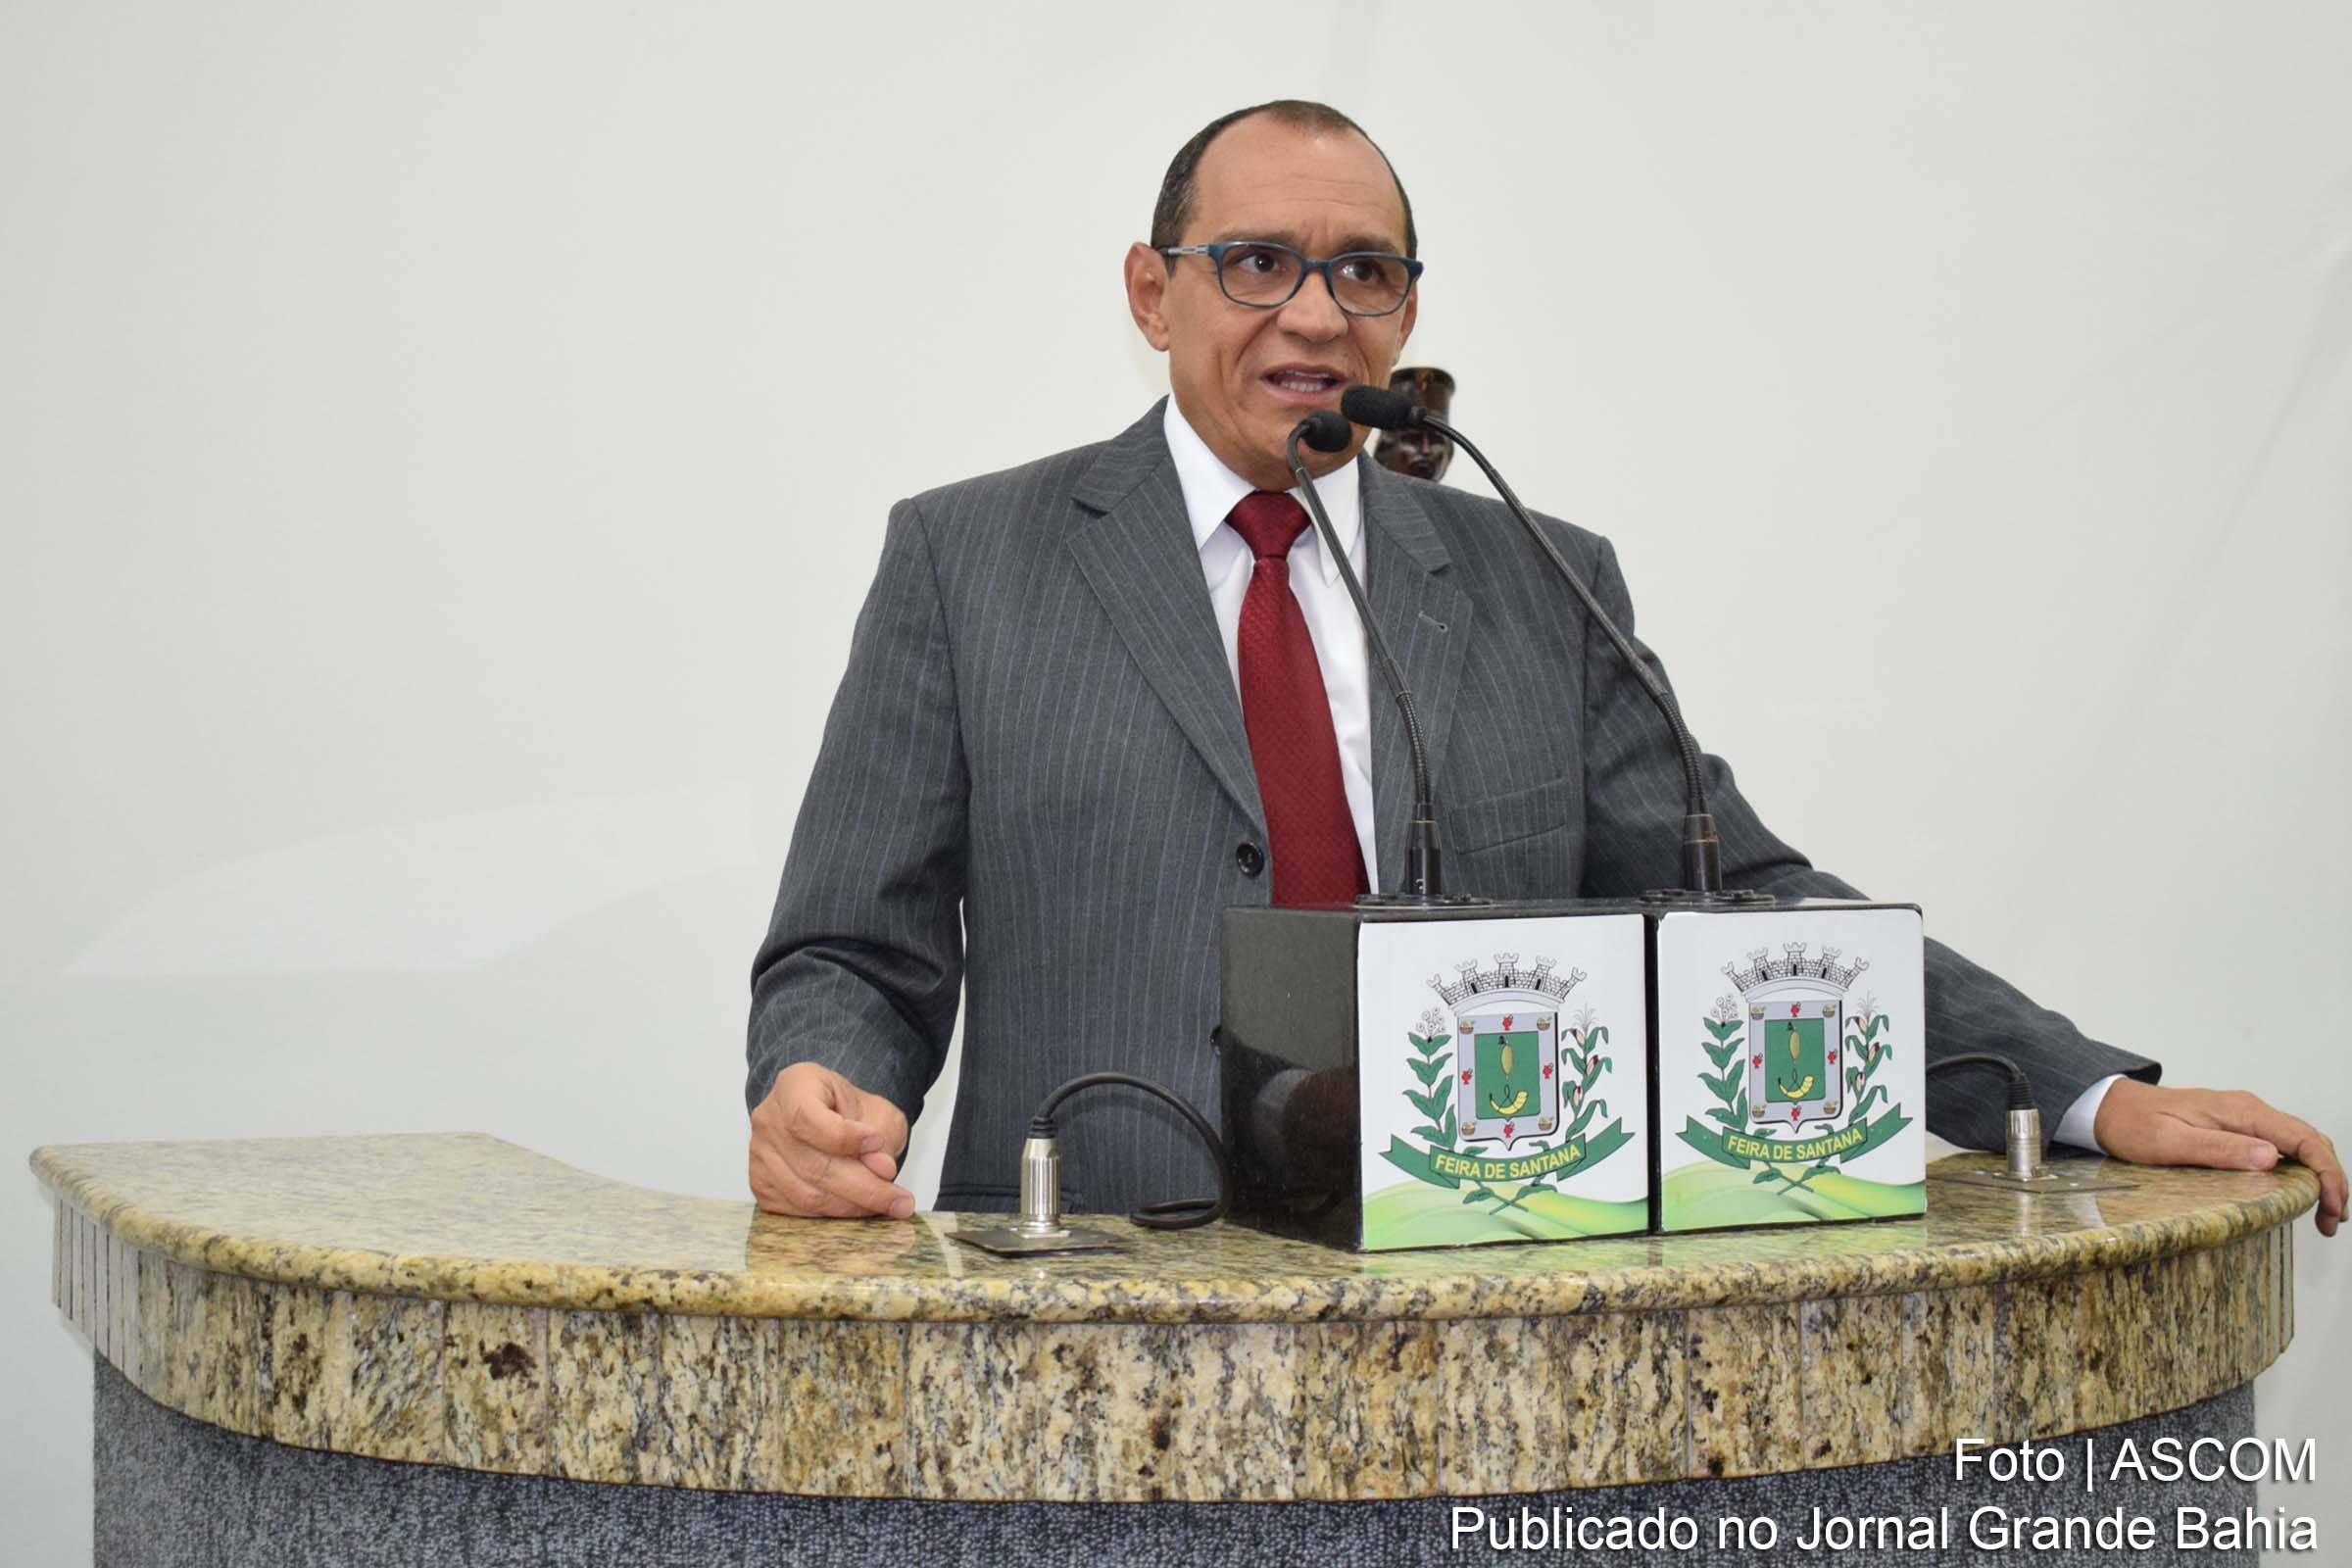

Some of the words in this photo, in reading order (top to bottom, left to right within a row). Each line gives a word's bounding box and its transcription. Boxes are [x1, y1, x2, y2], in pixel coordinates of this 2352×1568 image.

[1728, 1135, 1770, 1159] FEIRA
[1773, 1145, 1792, 1160] DE
[1796, 1128, 1862, 1159] SANTANA
[1435, 1154, 1481, 1178] FEIRA
[1485, 1163, 1505, 1179] DE
[1509, 1144, 1581, 1178] SANTANA
